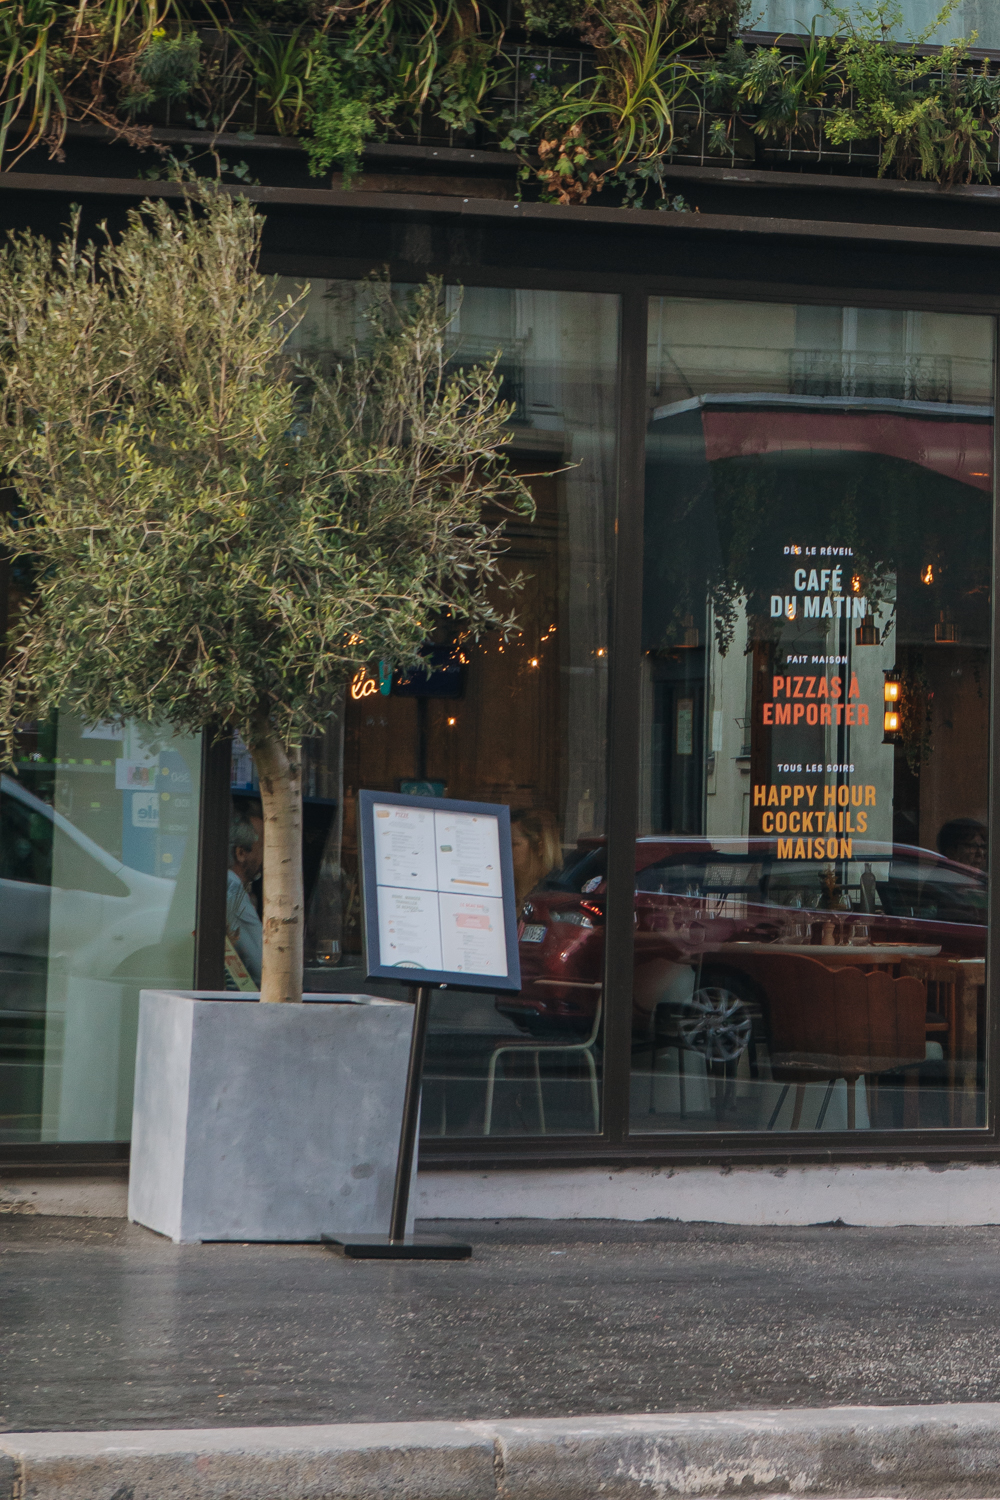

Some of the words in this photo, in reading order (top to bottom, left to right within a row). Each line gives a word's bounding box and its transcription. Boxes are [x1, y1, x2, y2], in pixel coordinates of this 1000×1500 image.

[806, 546, 817, 556] LE
[820, 545, 854, 557] RÉVEIL
[794, 565, 843, 592] CAFÉ
[770, 595, 796, 618] DU
[804, 596, 866, 618] MATIN
[786, 655, 808, 664] FAIT
[811, 655, 848, 665] MAISON
[772, 676, 842, 698] PIZZAS
[848, 671, 860, 699] À
[762, 703, 870, 726] EMPORTER
[777, 764, 802, 773] TOUS
[806, 764, 824, 773] LES
[827, 764, 855, 773] SOIRS
[753, 785, 816, 807] HAPPY
[824, 785, 876, 807] HOUR
[762, 811, 868, 833] COCKTAILS
[777, 838, 852, 860] MAISON
